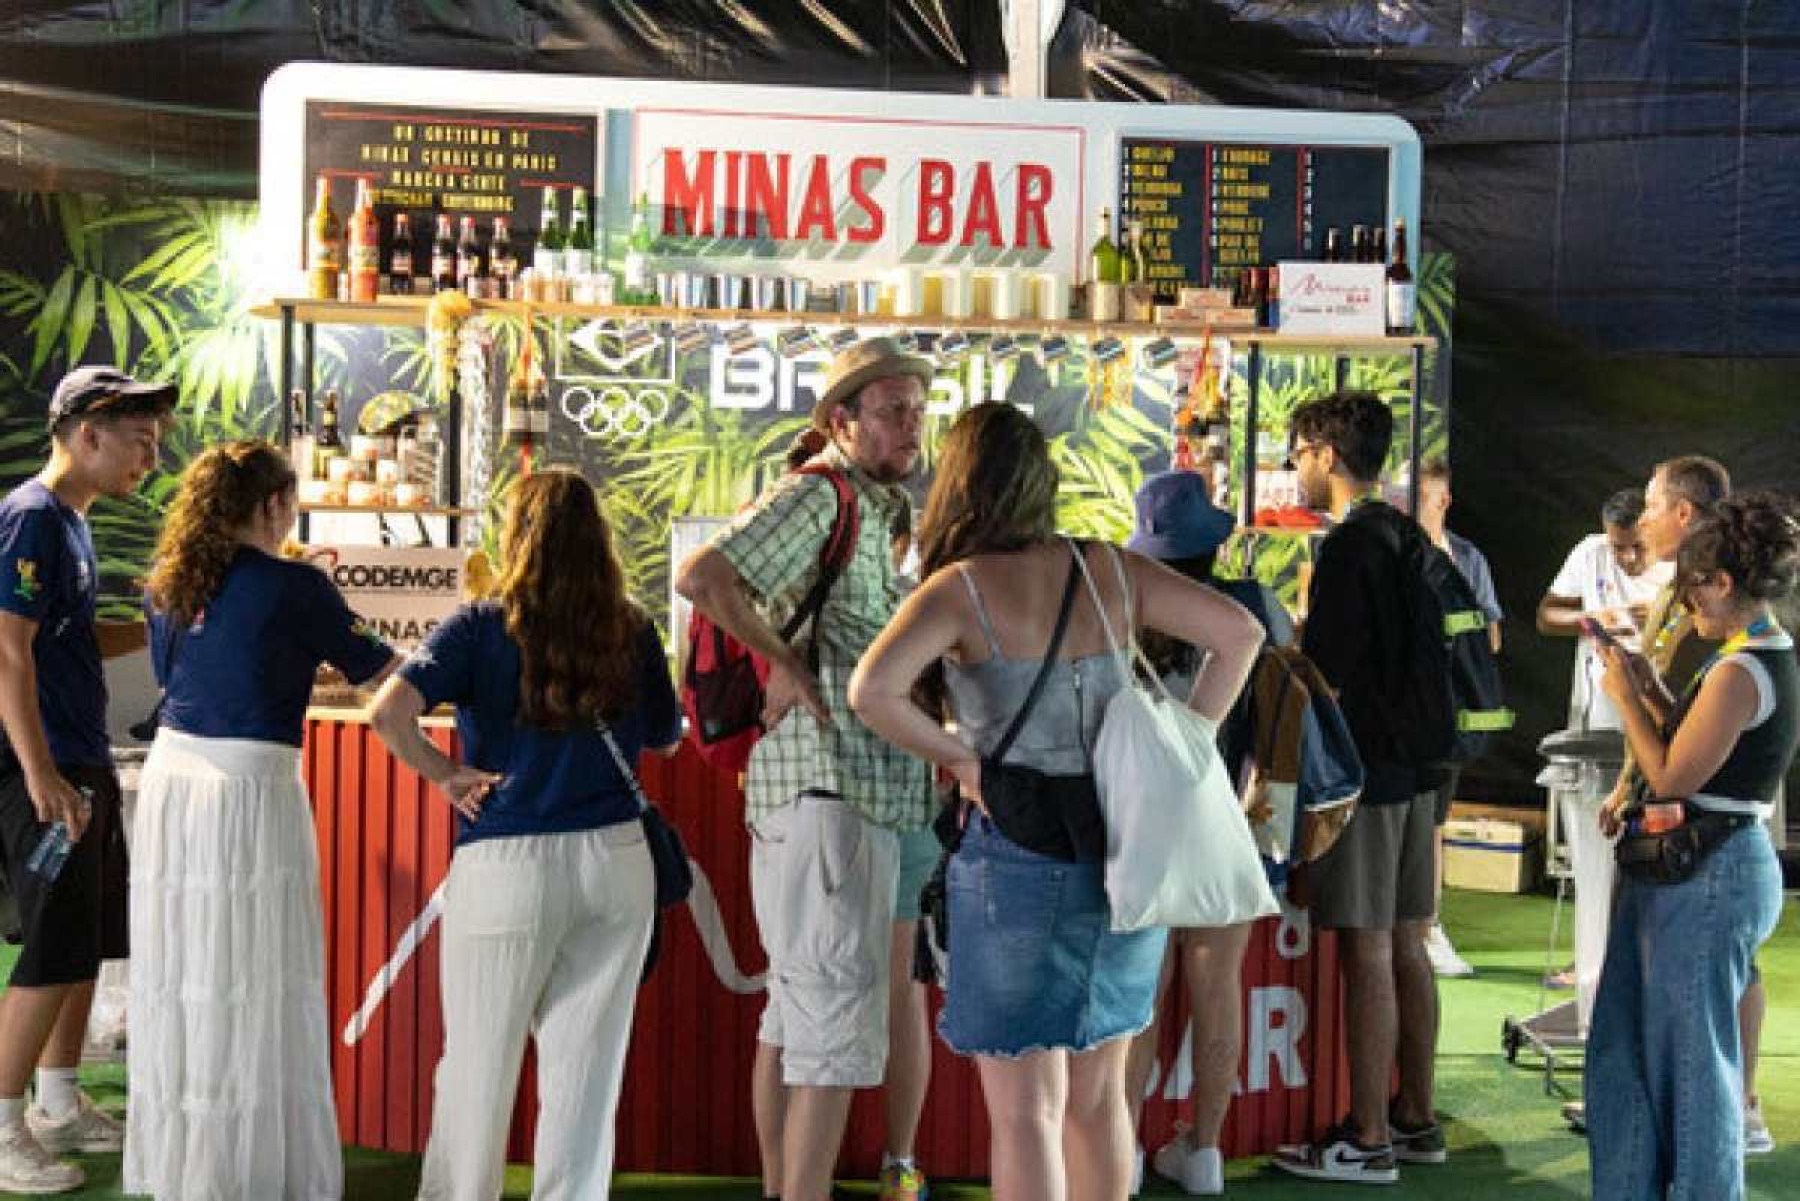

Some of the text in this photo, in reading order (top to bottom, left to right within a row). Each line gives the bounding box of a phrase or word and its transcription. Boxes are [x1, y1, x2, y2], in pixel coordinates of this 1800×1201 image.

[664, 148, 887, 243] MINAS
[917, 157, 1053, 249] BAR
[334, 565, 458, 589] CODEMGE
